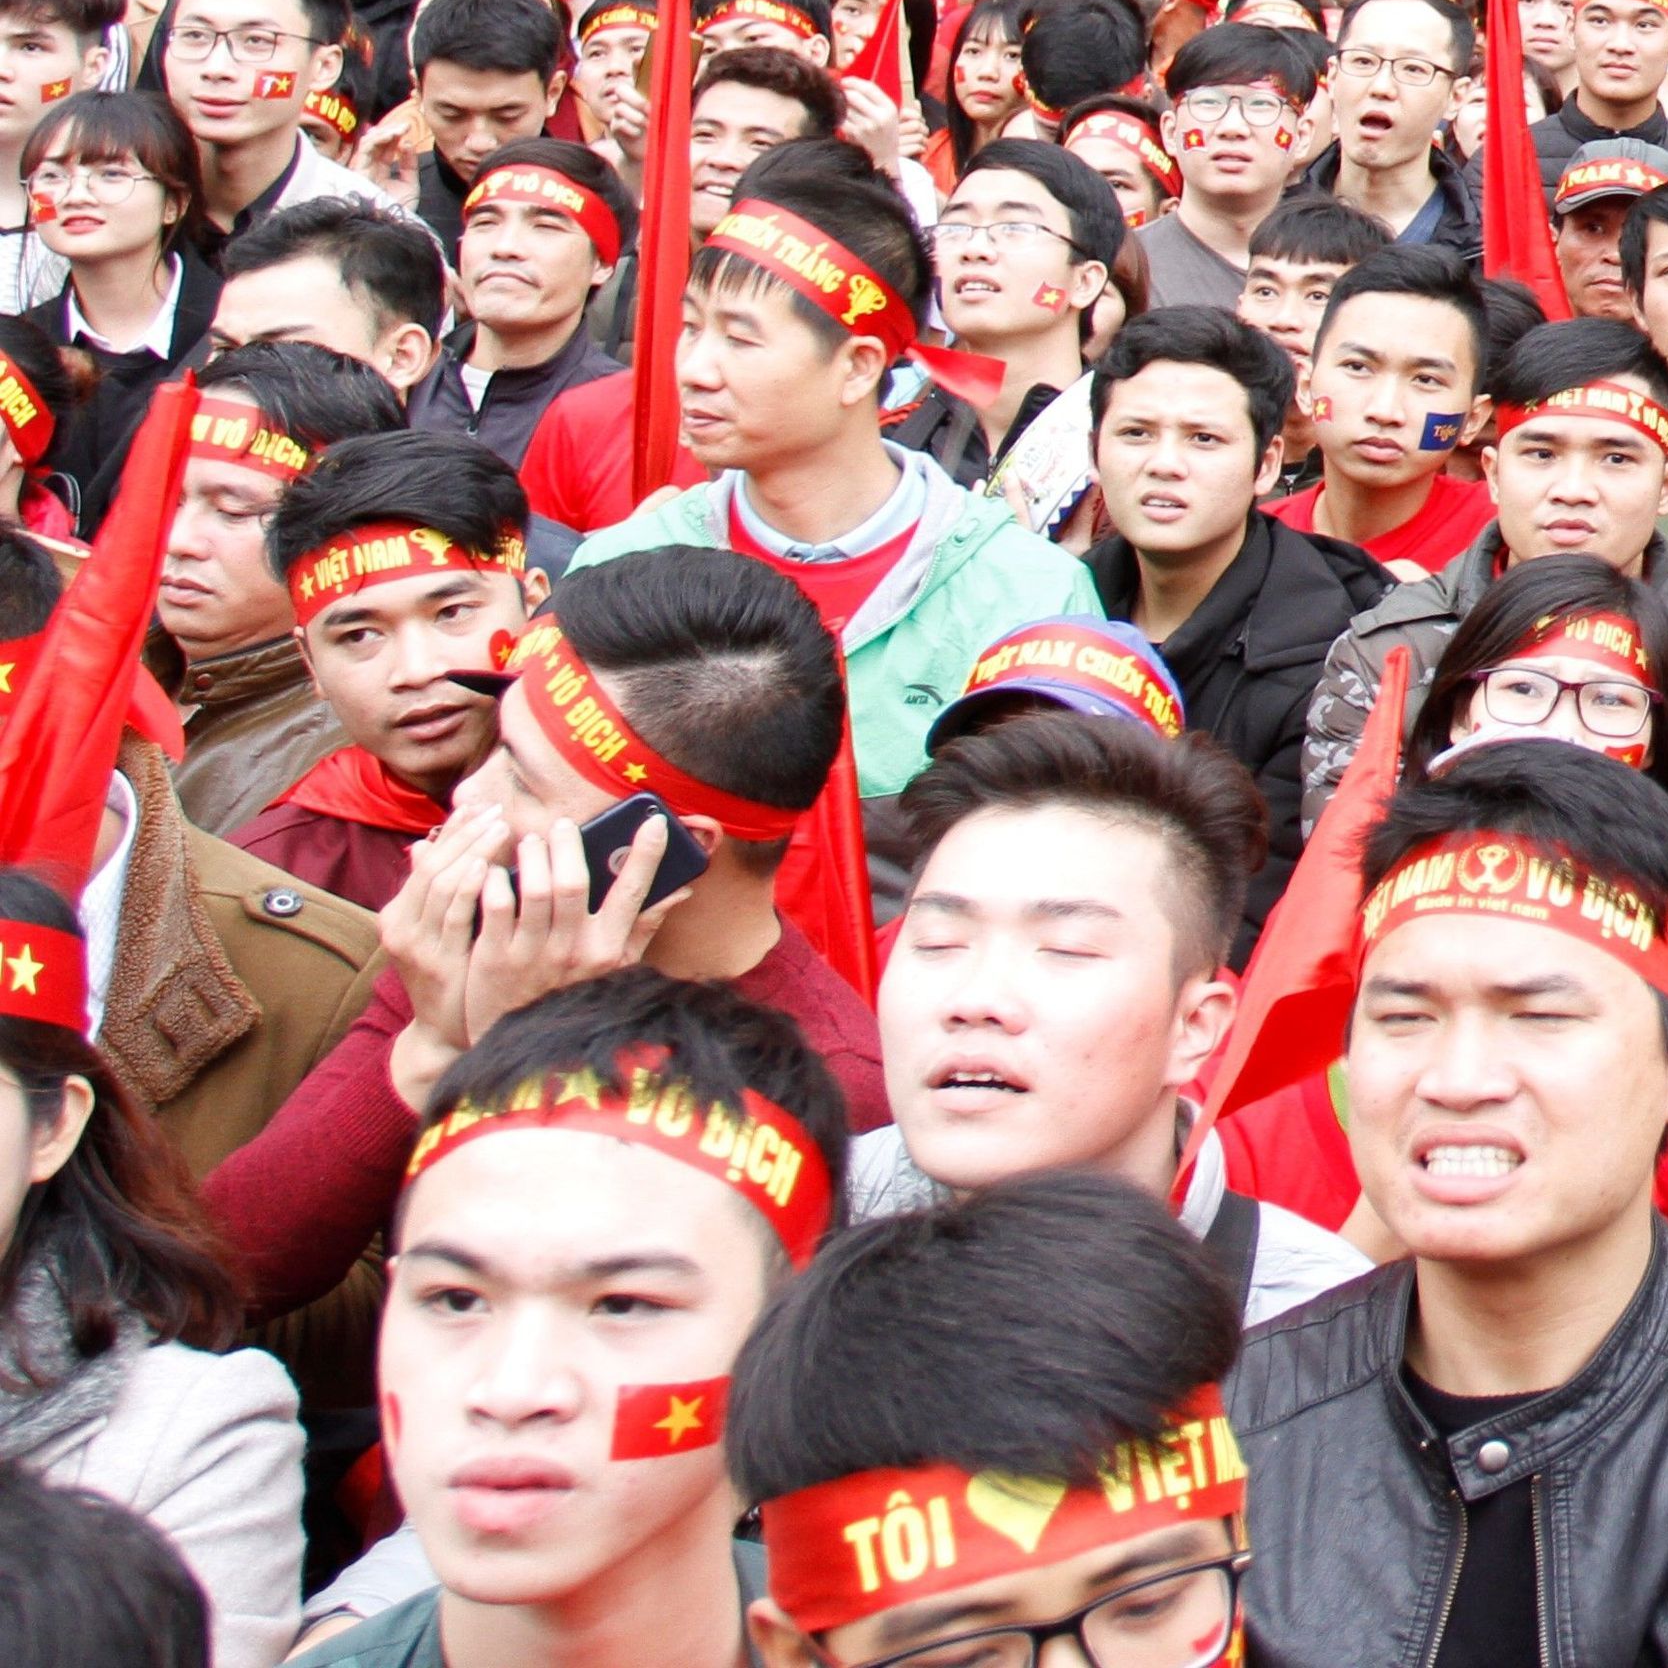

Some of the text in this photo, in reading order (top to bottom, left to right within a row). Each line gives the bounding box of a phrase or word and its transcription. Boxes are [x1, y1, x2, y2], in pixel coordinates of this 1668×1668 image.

[513, 174, 585, 214] VÔ ĐỊCH
[1569, 163, 1622, 189] NAM
[774, 228, 845, 294] THẮNG
[314, 535, 410, 596] VIỆT NAM
[546, 670, 628, 764] VÔ ĐỊCH
[844, 1490, 959, 1594] TÔI
